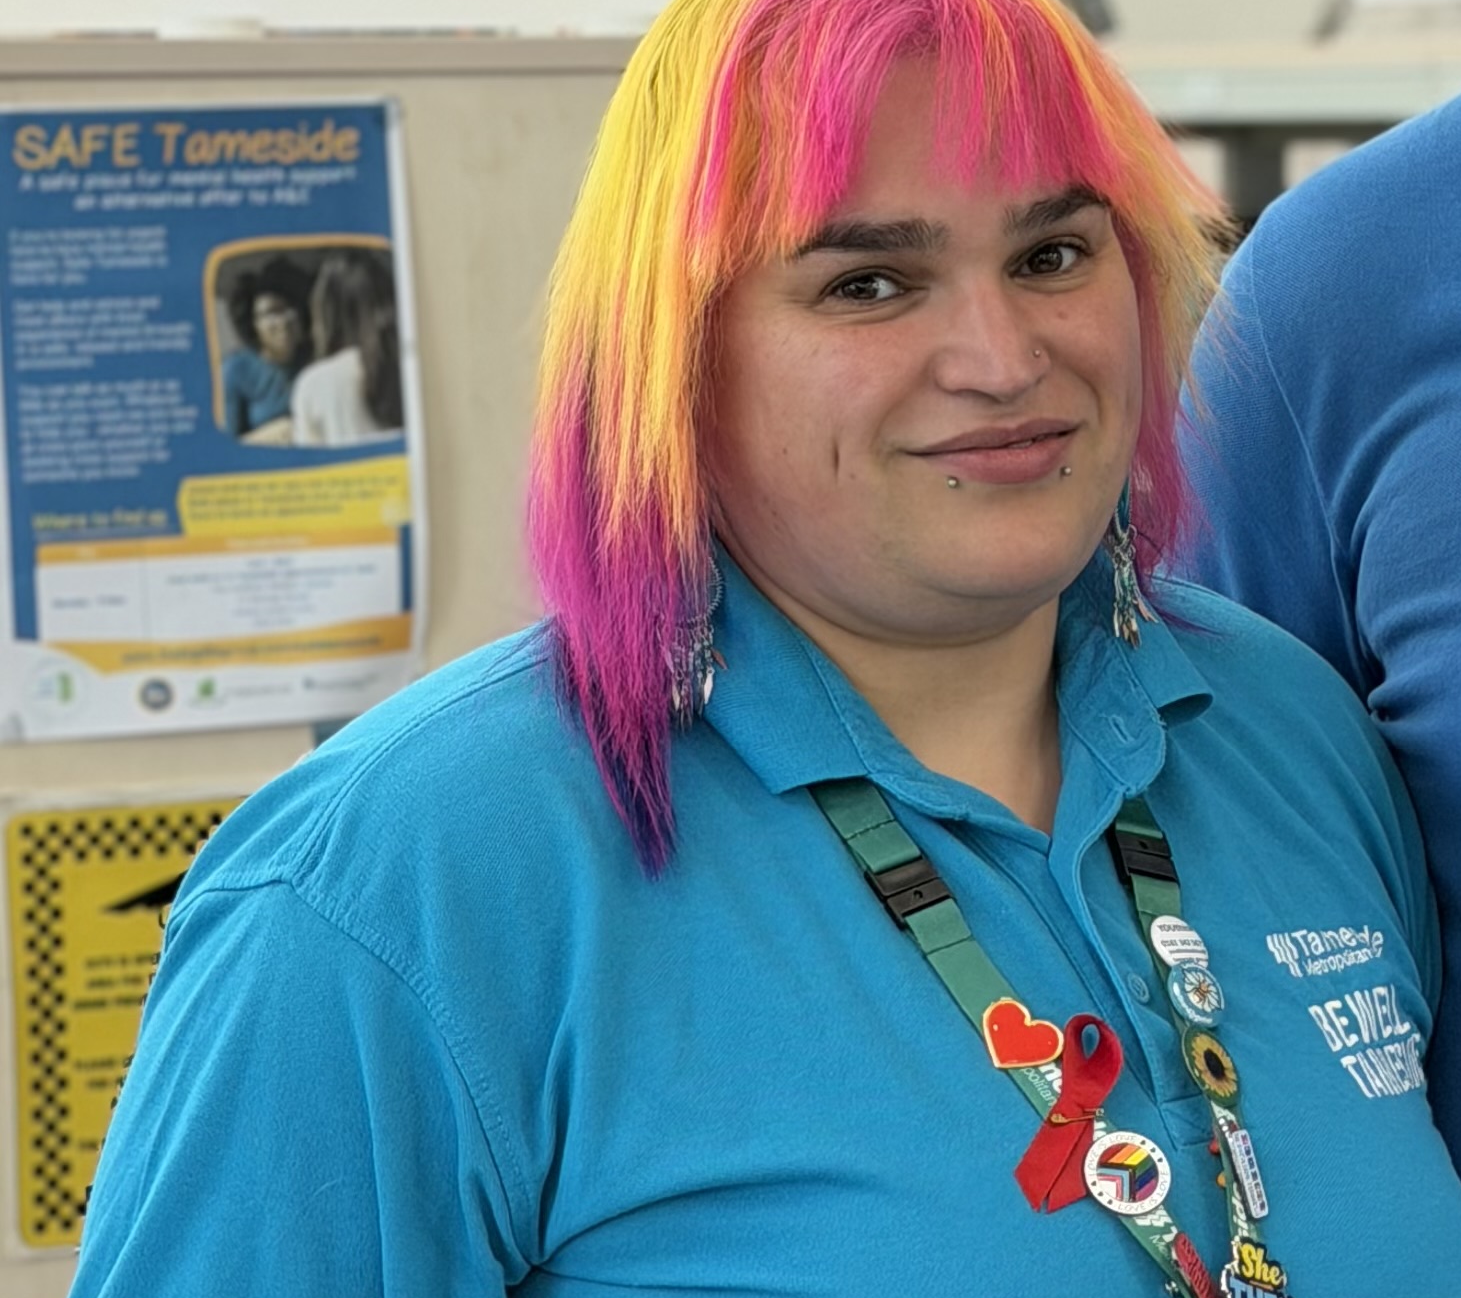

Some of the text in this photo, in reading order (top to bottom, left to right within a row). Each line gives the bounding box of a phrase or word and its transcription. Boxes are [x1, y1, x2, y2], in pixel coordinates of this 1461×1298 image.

[13, 117, 361, 170] SAFE Tameside
[1291, 925, 1384, 957] Tamede
[1308, 999, 1360, 1052] BE
[1241, 1243, 1285, 1286] She
